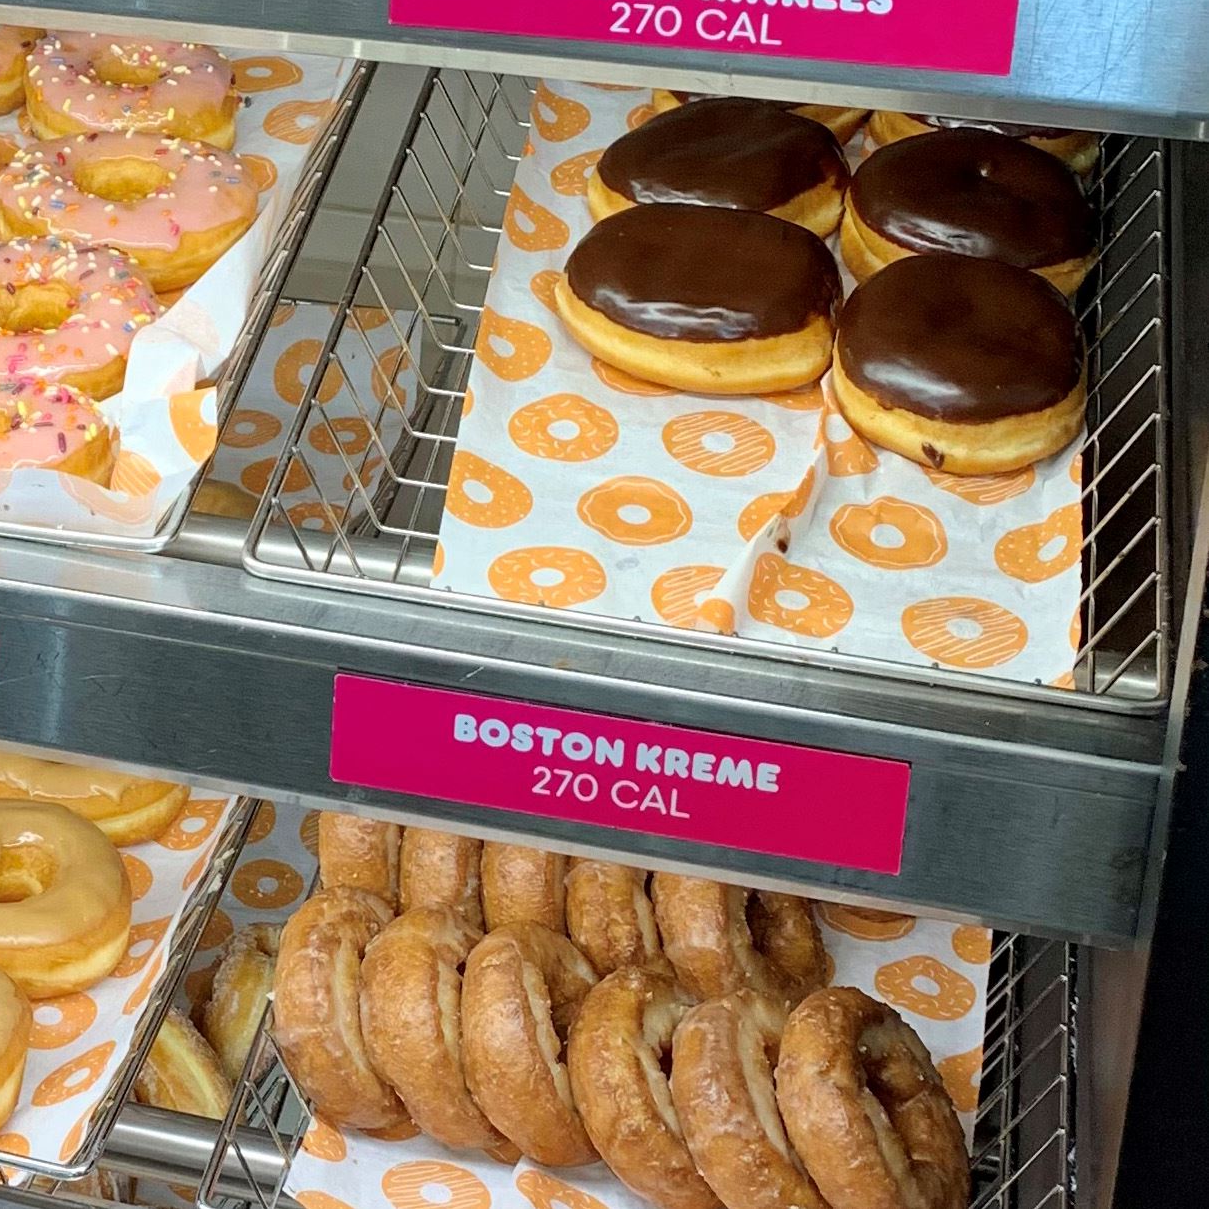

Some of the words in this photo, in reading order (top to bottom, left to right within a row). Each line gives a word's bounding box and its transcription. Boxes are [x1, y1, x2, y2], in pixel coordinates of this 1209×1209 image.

[609, 2, 682, 37] 270
[695, 8, 782, 45] CAL
[453, 713, 625, 768] BOSTON
[635, 742, 781, 793] KREME
[532, 766, 598, 801] 270
[611, 780, 690, 818] CAL
